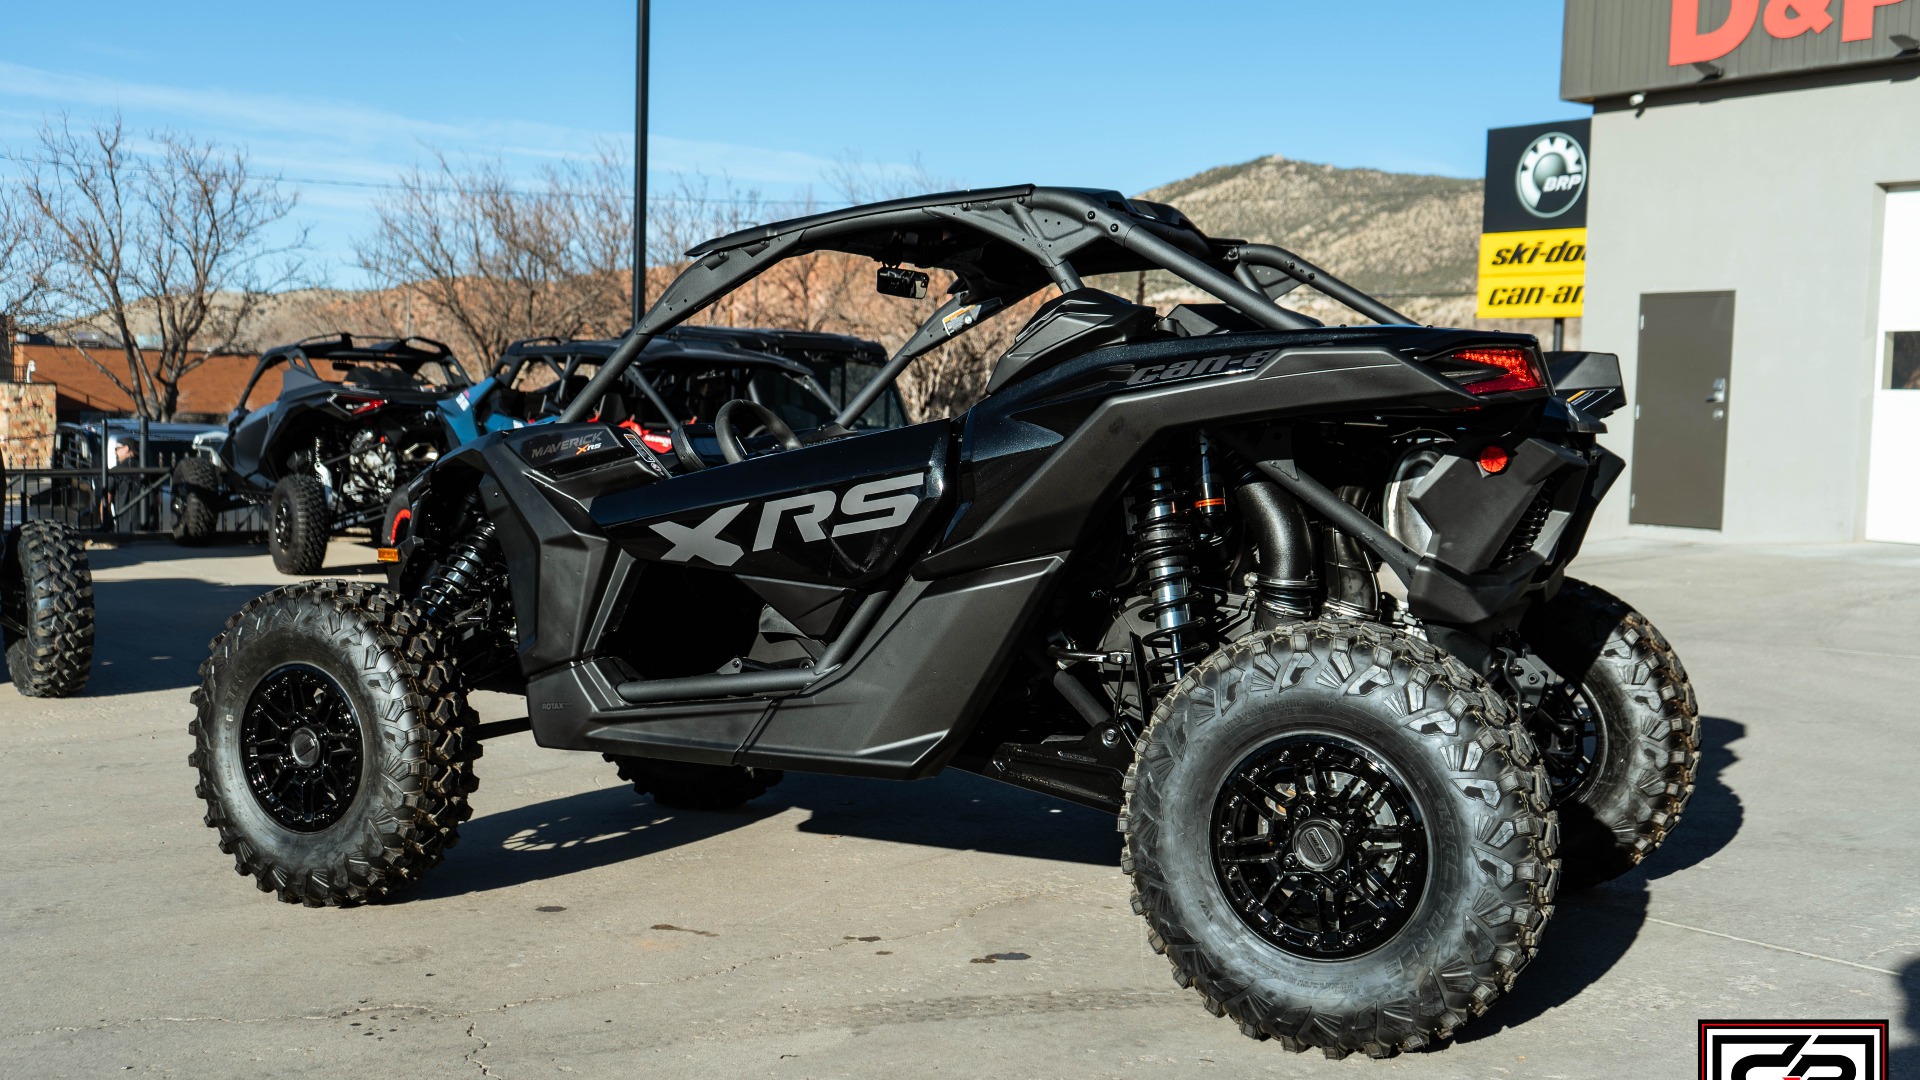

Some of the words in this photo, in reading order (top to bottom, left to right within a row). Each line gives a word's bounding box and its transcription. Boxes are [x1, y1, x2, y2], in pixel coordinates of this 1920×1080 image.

[1543, 174, 1583, 192] BRP
[1491, 240, 1586, 266] ski-do
[1127, 349, 1280, 386] can-a
[531, 431, 602, 459] MAVERICK
[576, 442, 602, 456] XRS
[649, 472, 924, 566] XRS
[541, 702, 564, 710] ROTAX
